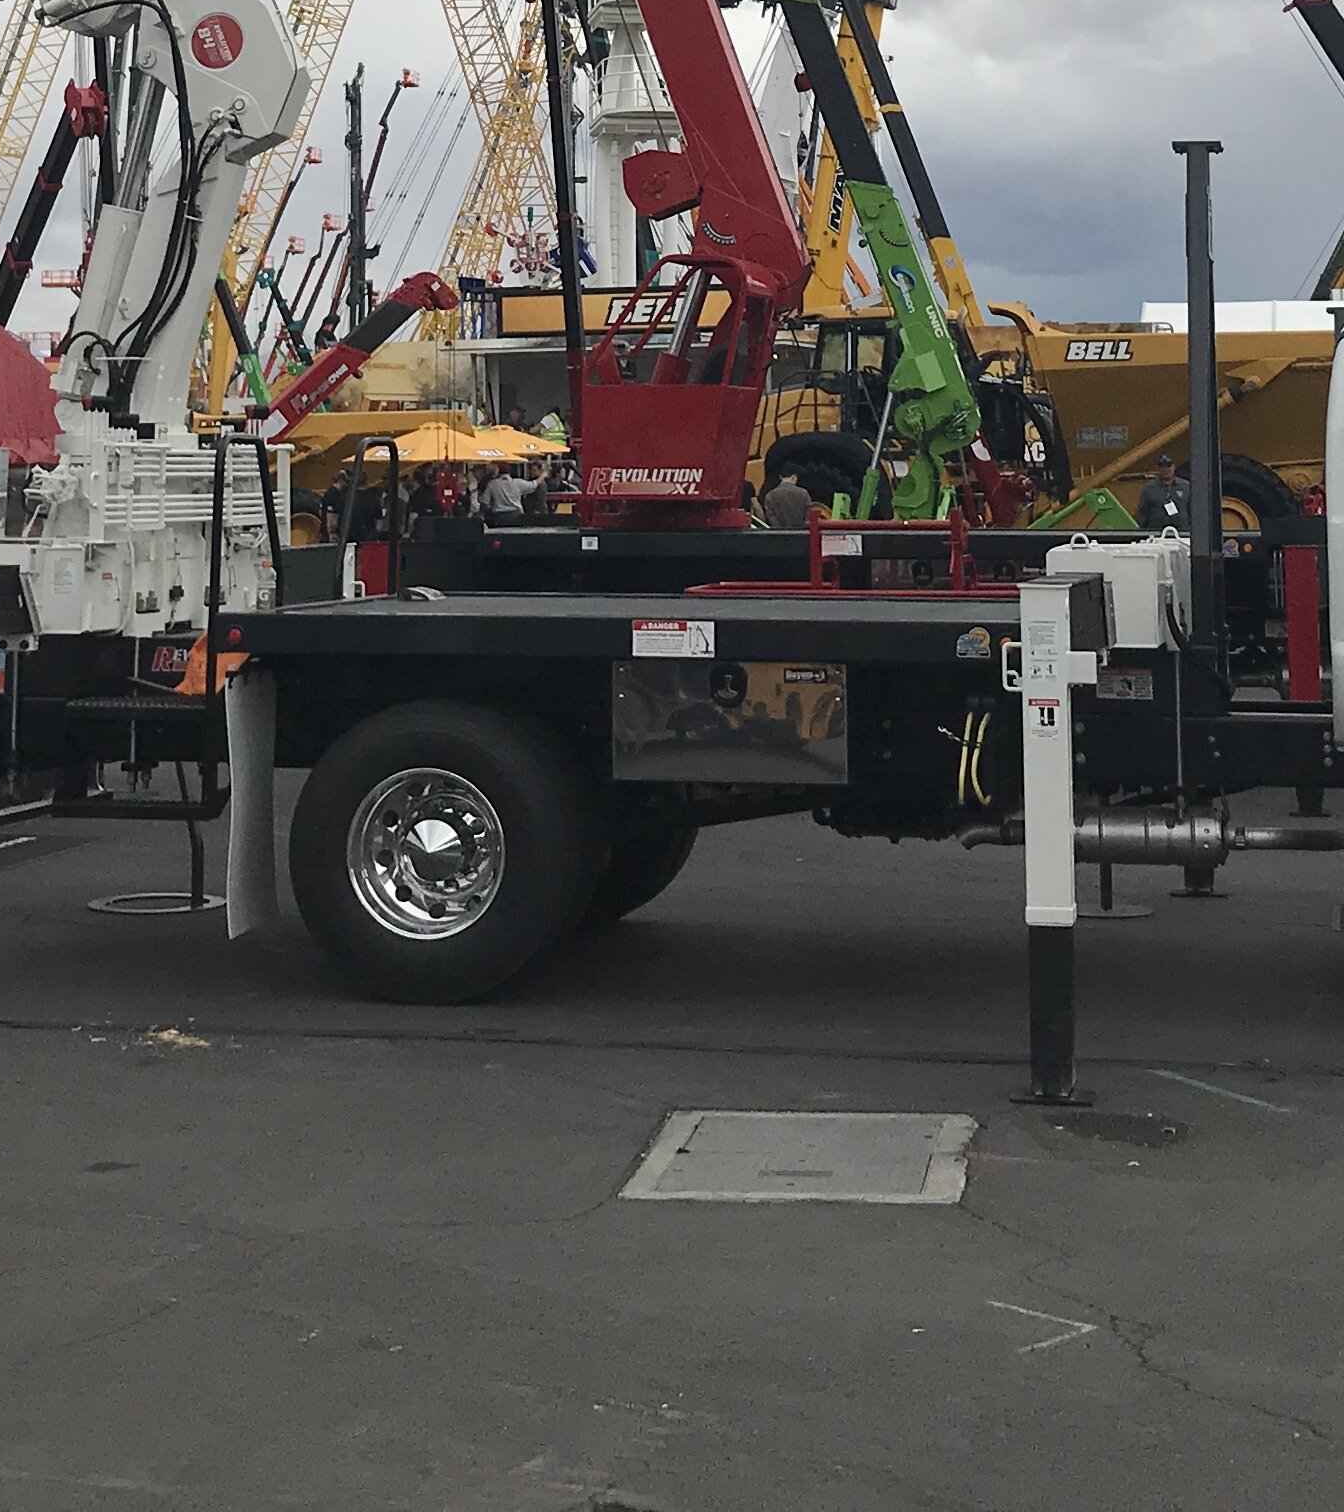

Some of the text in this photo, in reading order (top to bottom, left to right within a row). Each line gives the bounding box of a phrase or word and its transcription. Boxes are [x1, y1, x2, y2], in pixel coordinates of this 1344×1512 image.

[925, 305, 944, 338] UNIC
[1066, 340, 1133, 361] BELL
[586, 467, 704, 495] REVOLUTION
[672, 482, 700, 495] XL
